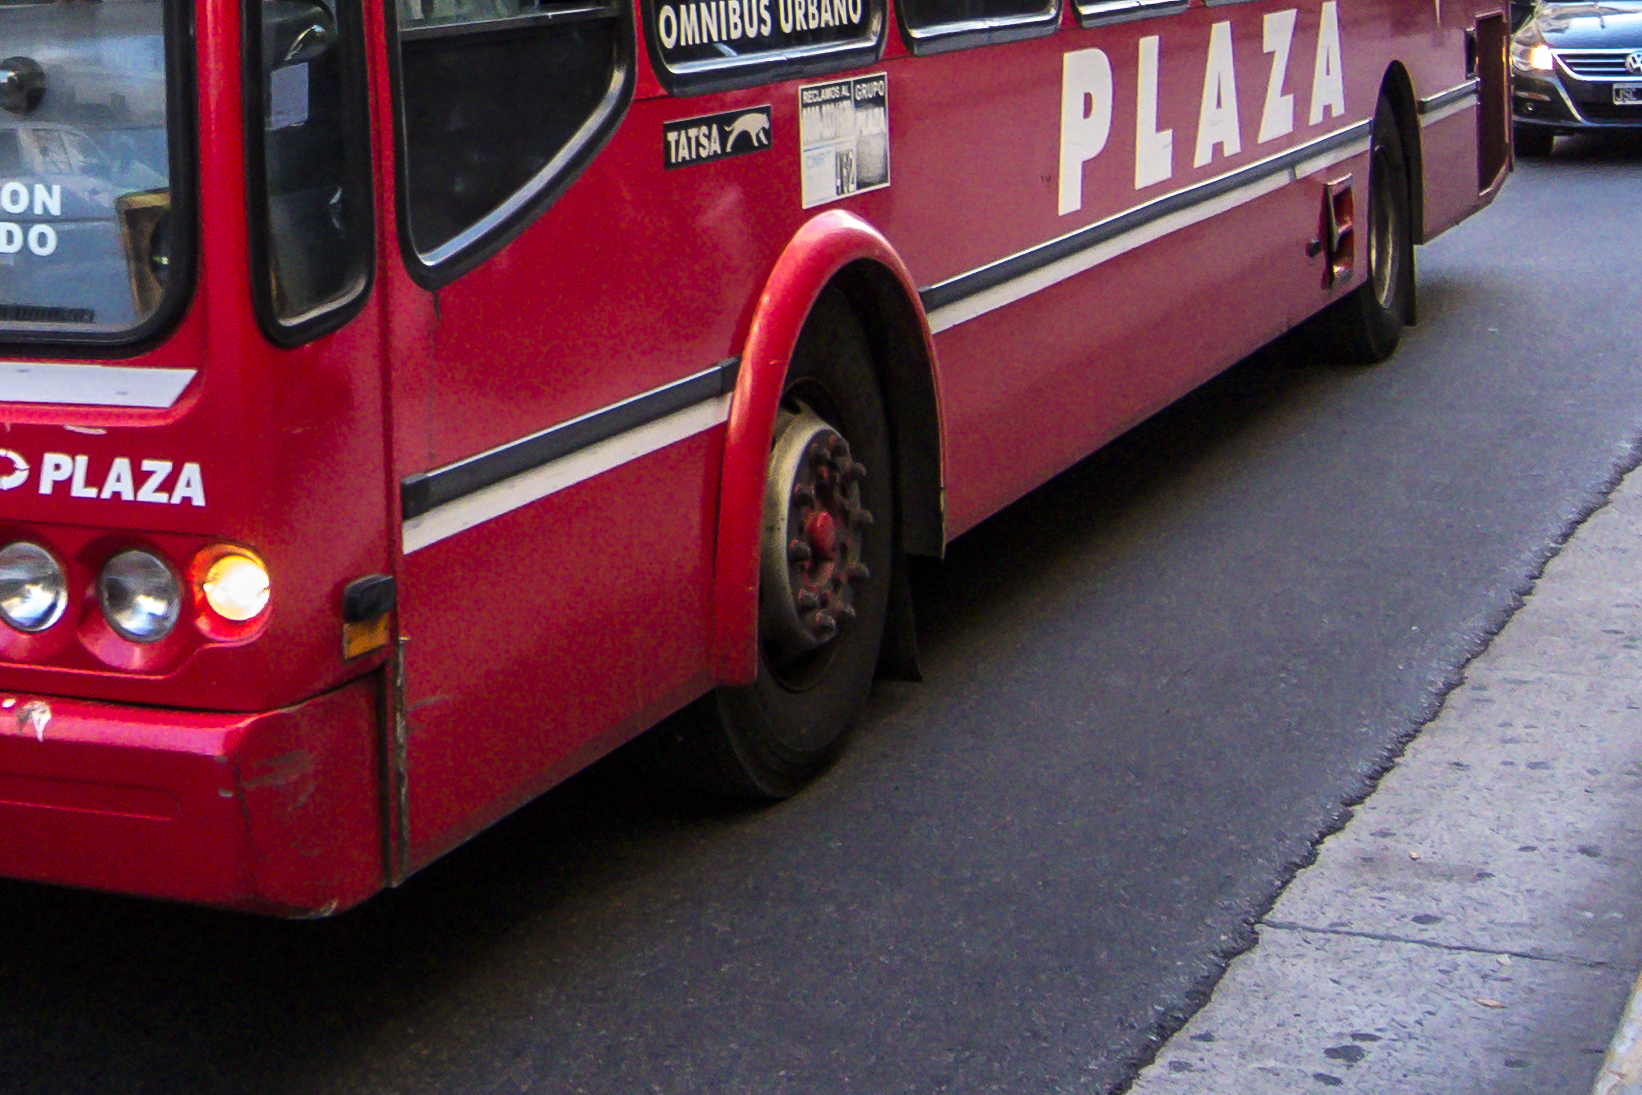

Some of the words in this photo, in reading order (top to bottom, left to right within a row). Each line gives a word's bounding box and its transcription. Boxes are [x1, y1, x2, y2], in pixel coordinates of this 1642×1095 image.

[855, 80, 885, 101] GRUPO
[1057, 0, 1346, 217] PLAZA
[666, 123, 722, 164] TATSA
[38, 452, 207, 507] PLAZA
